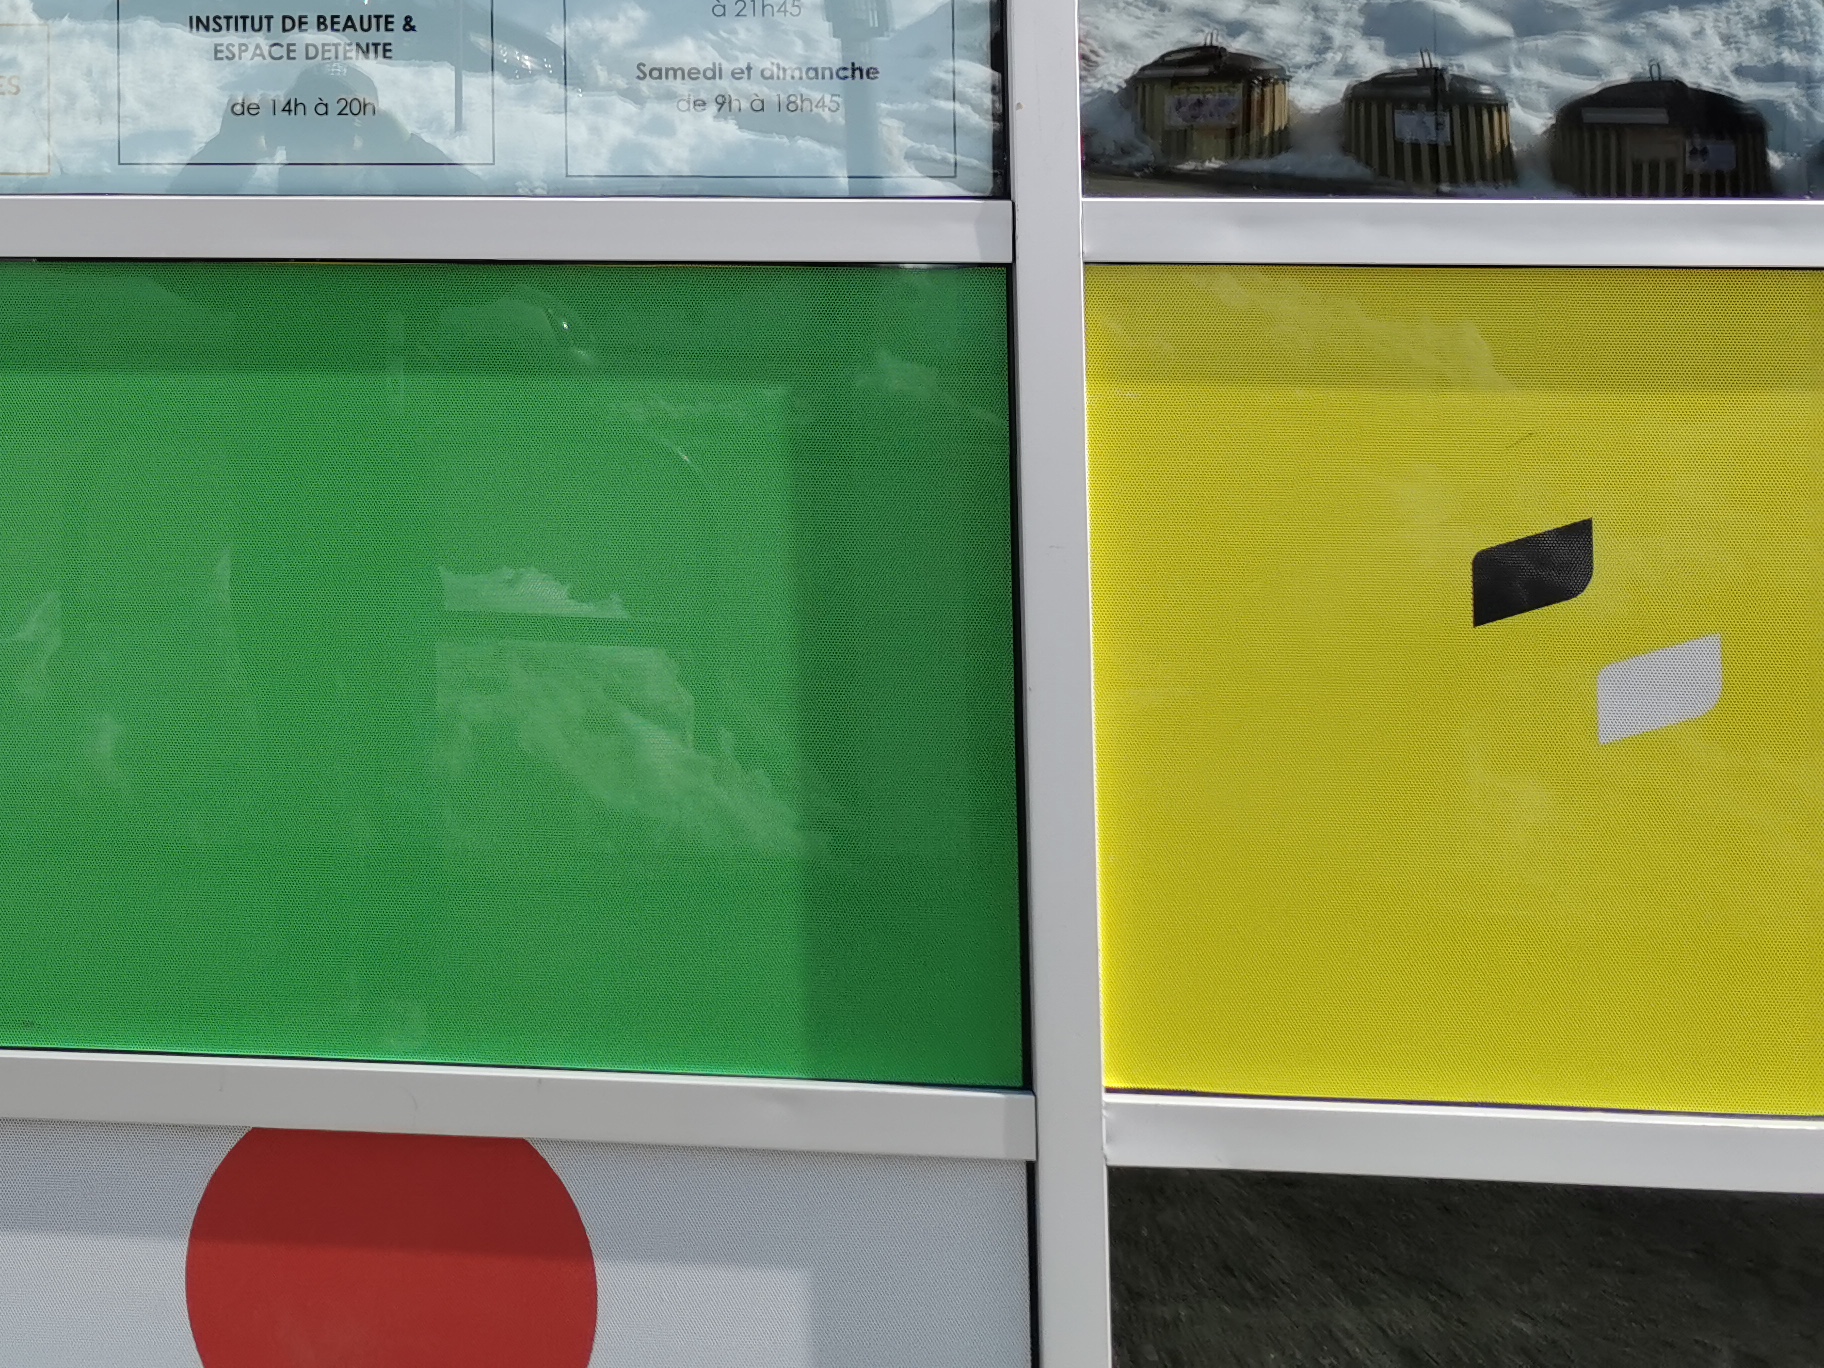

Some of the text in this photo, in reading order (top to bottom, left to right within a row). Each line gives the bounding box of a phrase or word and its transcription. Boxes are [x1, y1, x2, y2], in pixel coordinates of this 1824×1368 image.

[189, 14, 417, 33] INSTITUT DE BEAUTE &
[213, 42, 393, 61] ESPACE DETENTE
[636, 61, 880, 81] Samedi et dimanche
[231, 96, 376, 116] de 14h à 20h
